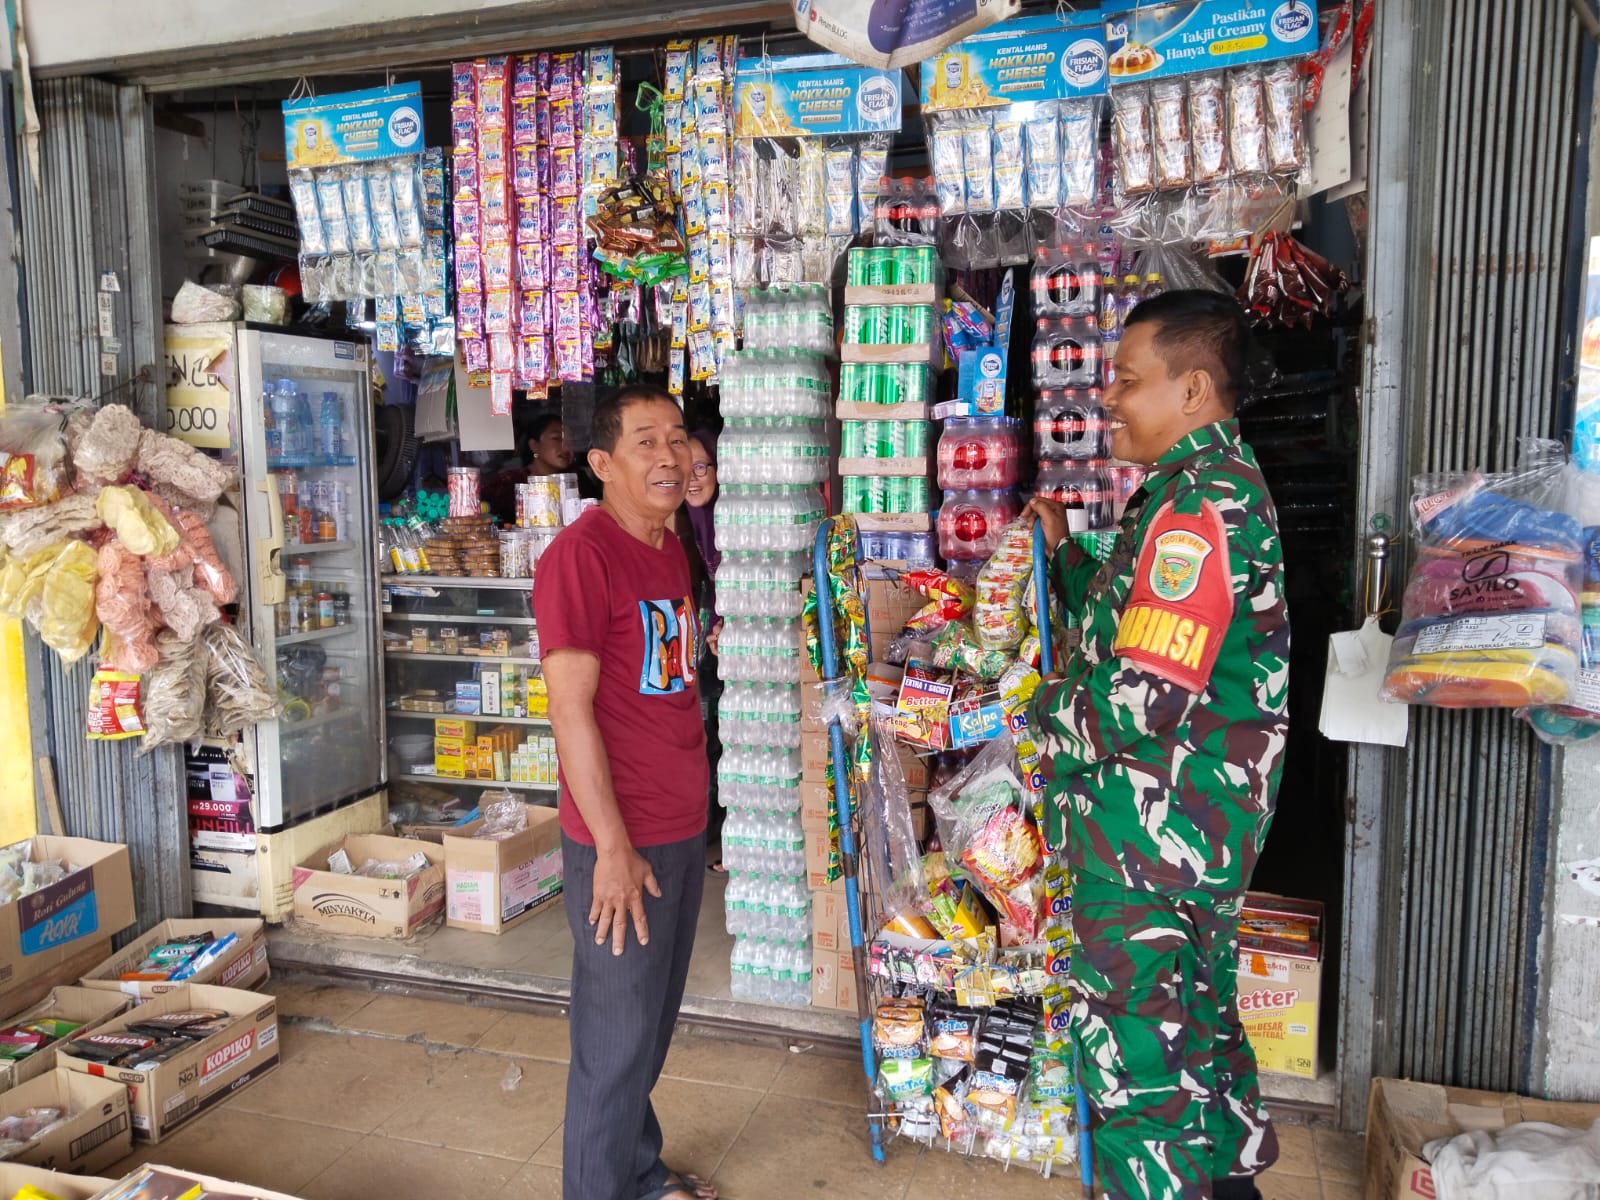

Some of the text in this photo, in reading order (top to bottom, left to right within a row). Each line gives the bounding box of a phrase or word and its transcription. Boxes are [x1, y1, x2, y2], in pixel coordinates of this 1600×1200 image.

[1212, 7, 1266, 25] Pastikan
[1278, 15, 1305, 25] FRISIAN
[1180, 21, 1267, 44] Takjil Creamy
[996, 43, 1048, 55] KENTAL MANIS
[1166, 46, 1206, 60] Hanya
[700, 56, 717, 65] Klin
[988, 52, 1056, 69] HOKKAIDO
[1069, 56, 1099, 66] FRISIAN
[997, 66, 1047, 81] CHEESE
[1074, 64, 1093, 73] FLAG
[797, 78, 845, 88] KENTAL MANIS
[790, 87, 851, 101] HOKKAIDO
[863, 93, 890, 102] FRISIAN
[701, 106, 718, 115] Klin
[798, 100, 844, 113] CHEESE
[336, 118, 384, 133] HOKKAIDO
[343, 129, 379, 143] CHEESE
[1462, 540, 1516, 557] TRADE MARK
[1450, 578, 1519, 600] SAVILO
[905, 679, 922, 690] EXTRA
[928, 685, 950, 697] SACHET
[906, 696, 942, 706] Better
[961, 710, 998, 731] Kalpa
[33, 880, 87, 921] Roti Gulung
[319, 903, 377, 925] MINYAKITA
[221, 952, 252, 984] KOPIKO
[1239, 990, 1295, 1010] etter
[206, 1033, 252, 1072] KOPIKO
[231, 1073, 250, 1089] Coffee
